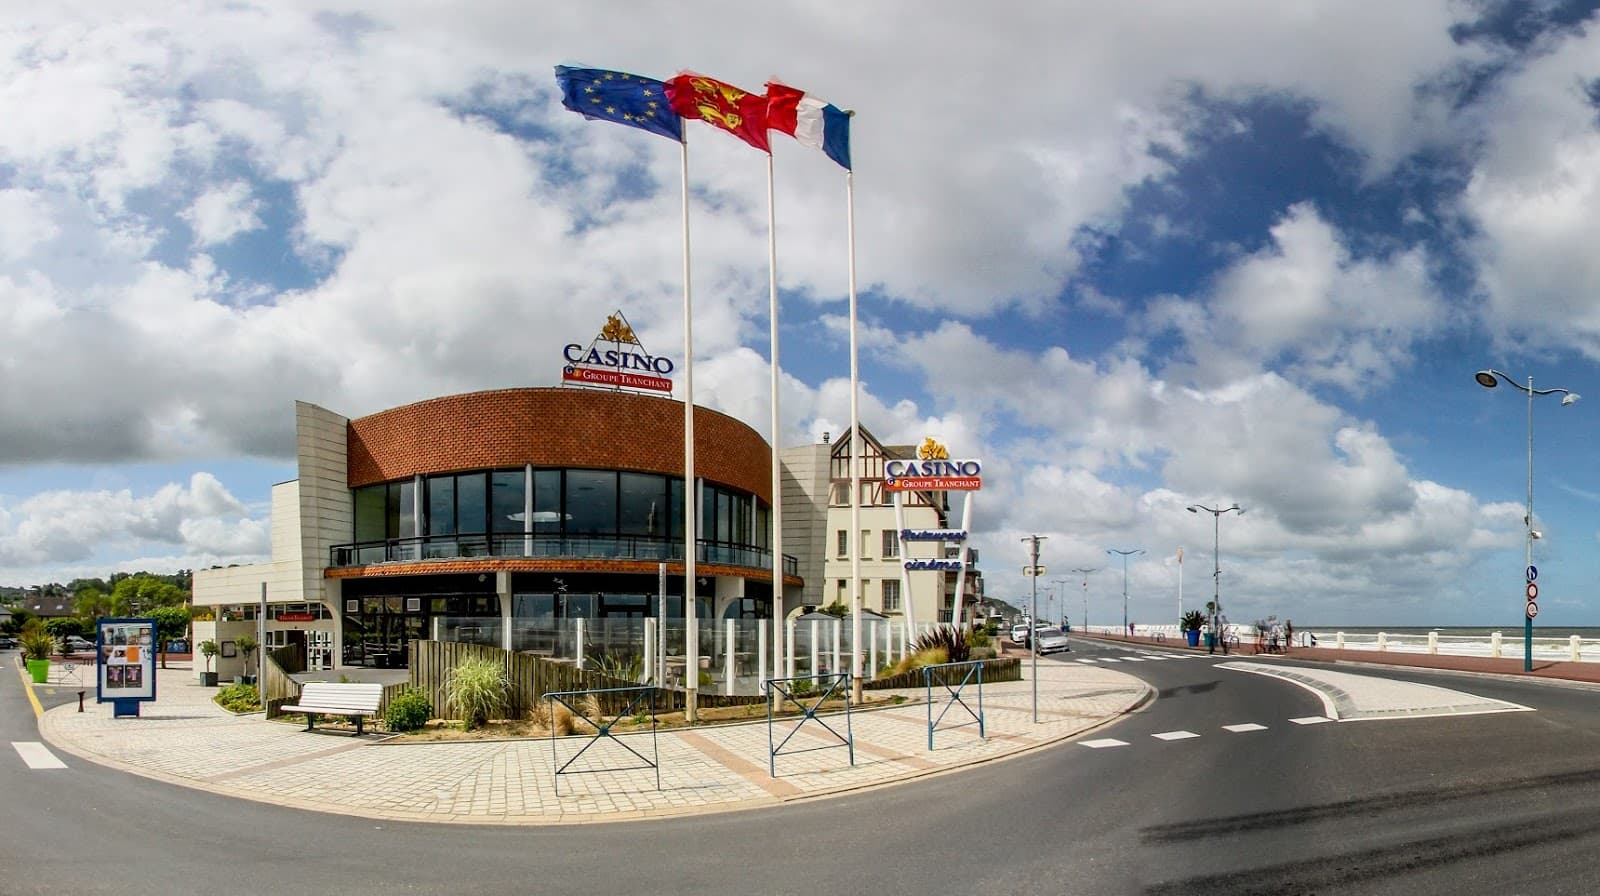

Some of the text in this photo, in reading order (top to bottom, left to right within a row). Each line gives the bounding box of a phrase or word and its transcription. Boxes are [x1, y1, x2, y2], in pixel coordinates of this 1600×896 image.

[564, 344, 674, 374] CASINO
[583, 370, 619, 383] GROUPE
[620, 374, 671, 389] TRANCHANT
[886, 461, 981, 477] CASINO
[902, 479, 933, 488] GROUPE
[933, 479, 980, 488] TRANCHANT
[904, 558, 962, 570] cinéma
